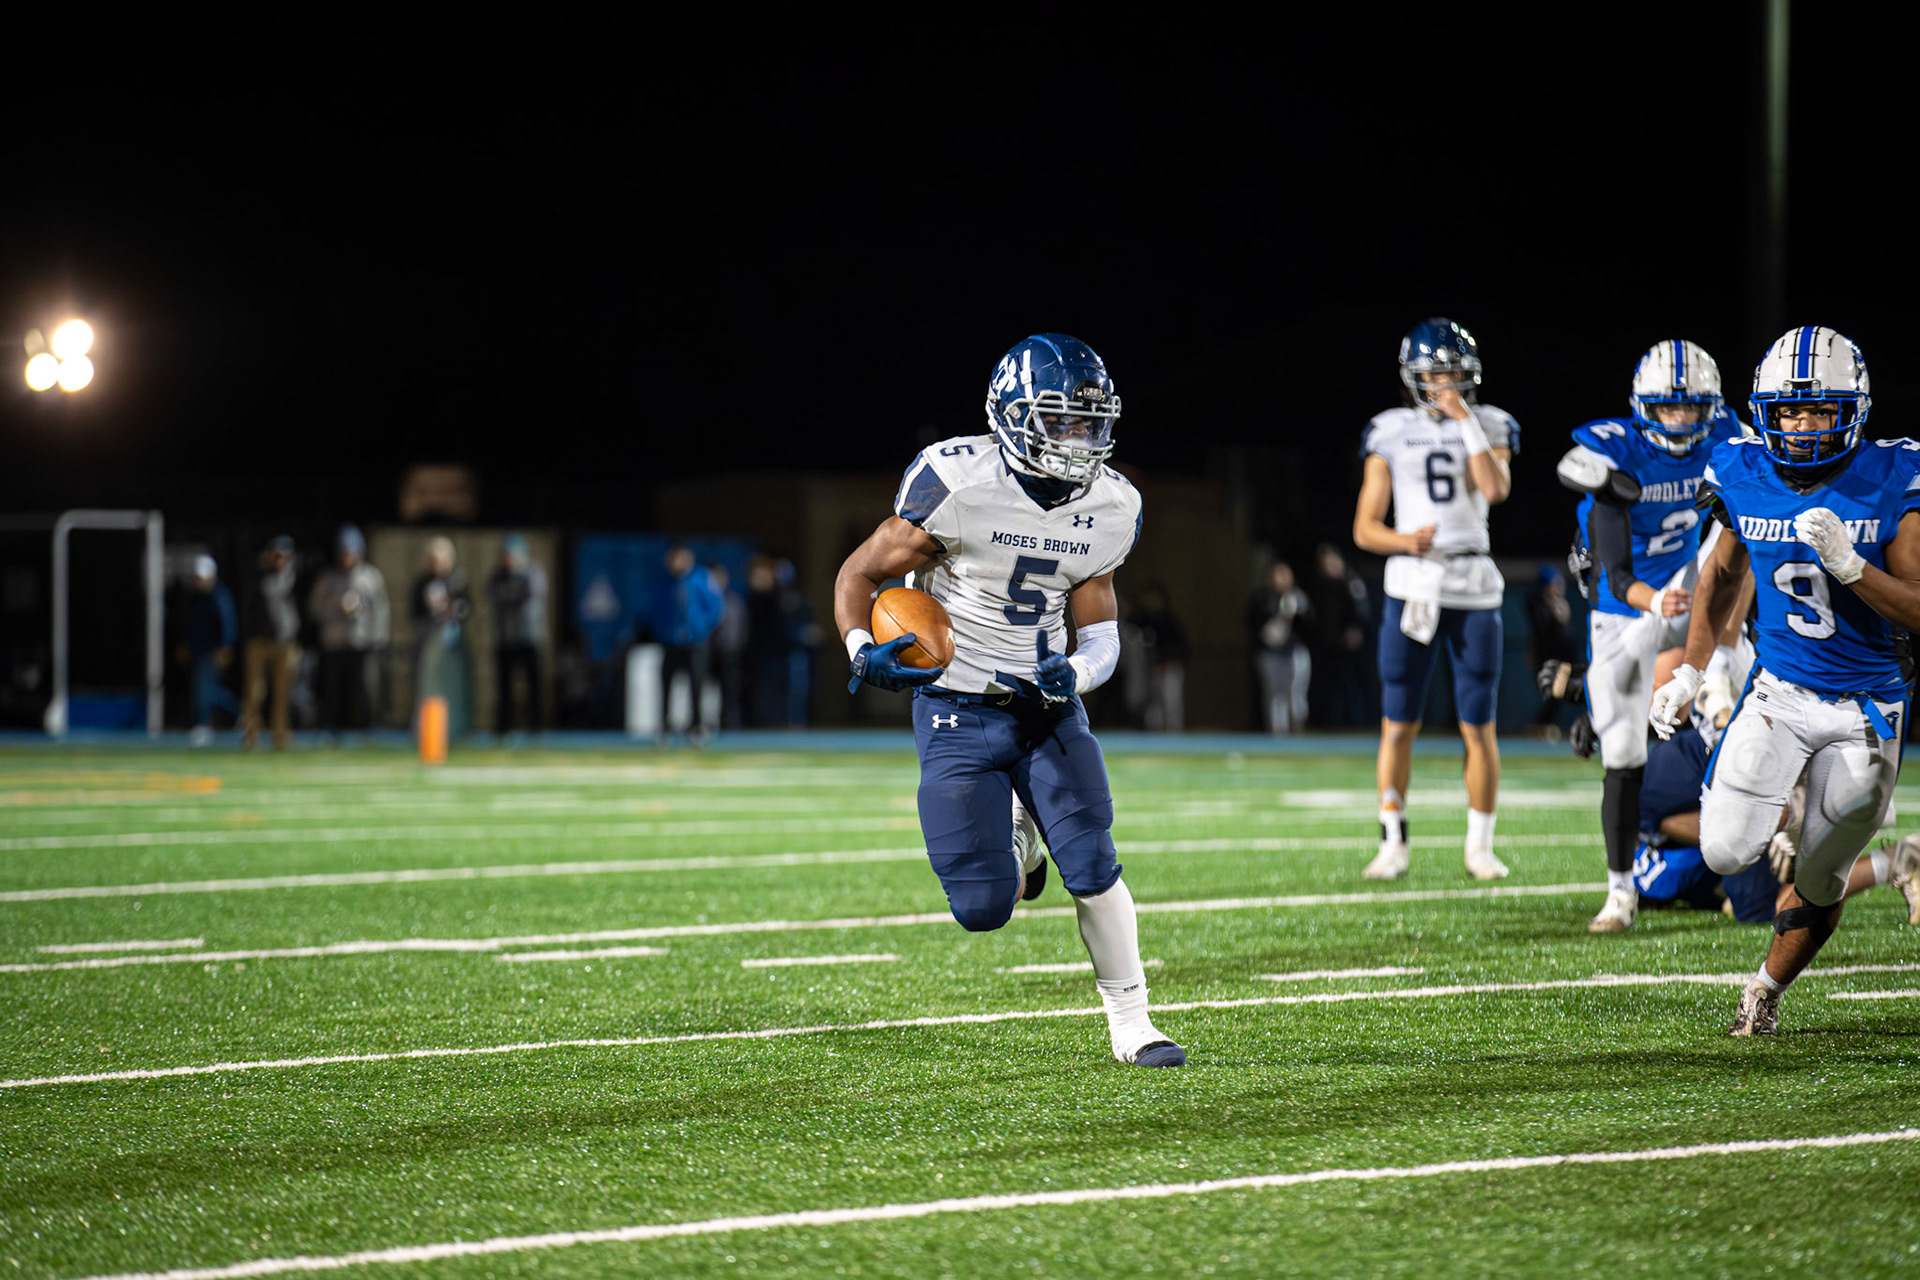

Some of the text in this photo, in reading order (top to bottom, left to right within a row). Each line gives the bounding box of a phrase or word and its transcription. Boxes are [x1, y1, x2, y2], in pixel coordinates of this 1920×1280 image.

[940, 444, 975, 459] 5
[1426, 452, 1455, 504] 6
[992, 531, 1091, 555] MOSES BROWN
[1646, 508, 1699, 557] 2
[1737, 515, 1880, 544] IDDLWN
[1003, 553, 1061, 626] 5
[1773, 561, 1837, 640] 9
